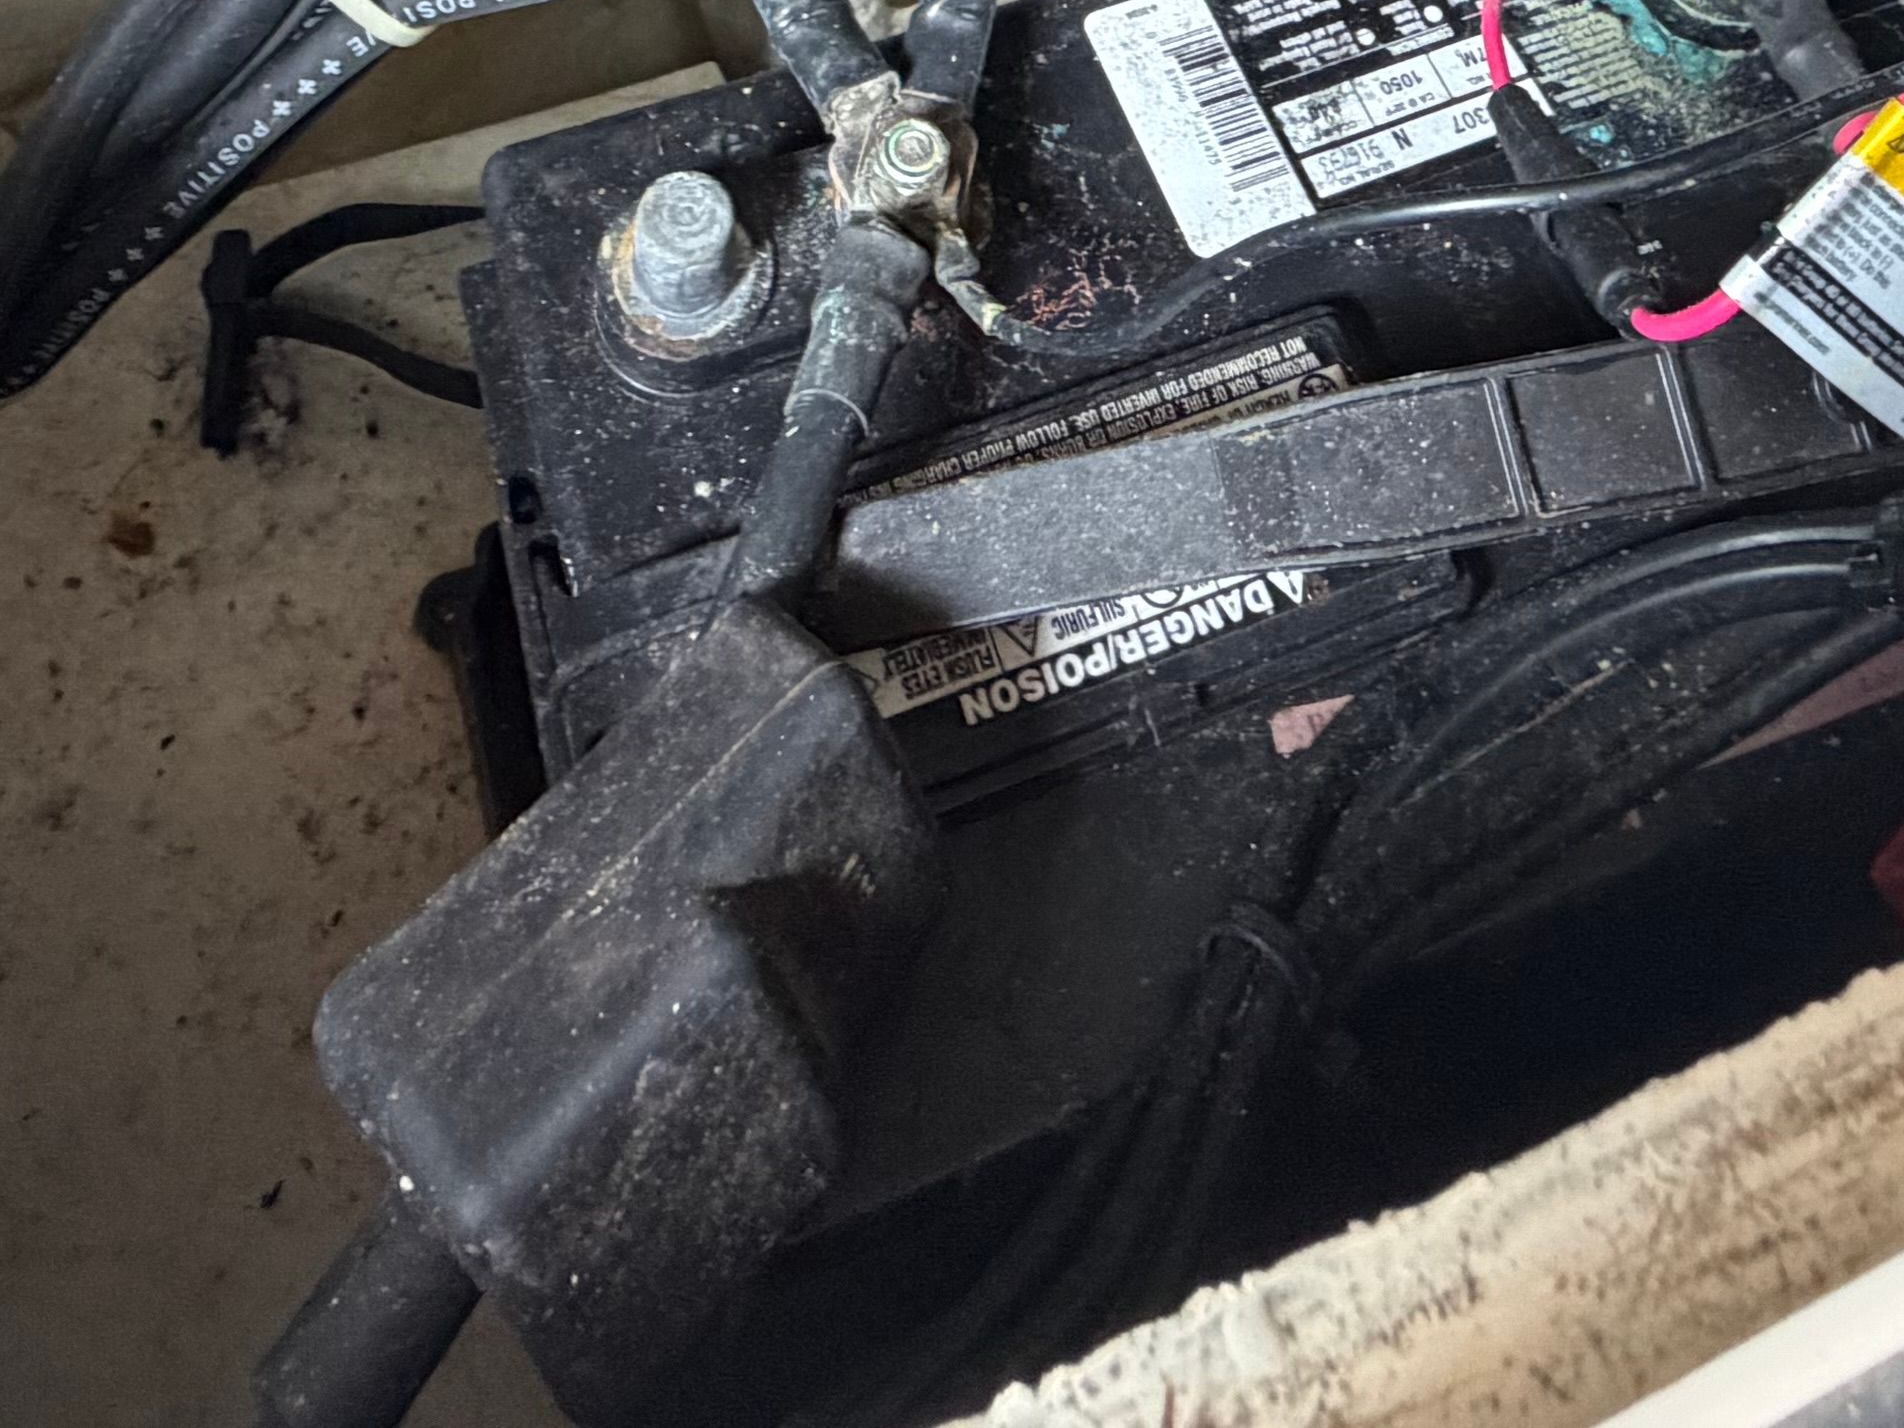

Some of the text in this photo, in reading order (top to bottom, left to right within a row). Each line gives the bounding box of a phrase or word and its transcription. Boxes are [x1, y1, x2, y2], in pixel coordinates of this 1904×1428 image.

[1378, 68, 1422, 96] 1050
[1389, 126, 1412, 152] N
[163, 120, 271, 220] POSITIVE
[1279, 333, 1305, 358] NOT
[1186, 342, 1279, 390] RECOMMENDED
[1226, 370, 1258, 396] RISK
[1258, 349, 1319, 385] WARNING:
[1098, 383, 1160, 420] INVERTED
[1160, 375, 1186, 399] FOR
[1208, 381, 1227, 403] OF
[1014, 415, 1067, 448] FOLLOW
[1105, 400, 1174, 439] EXPLOSION
[960, 434, 1012, 468] PROPER
[1049, 595, 1126, 640] SULFURIC
[957, 576, 1274, 726] DANGER/POISON
[897, 664, 944, 699] EYES
